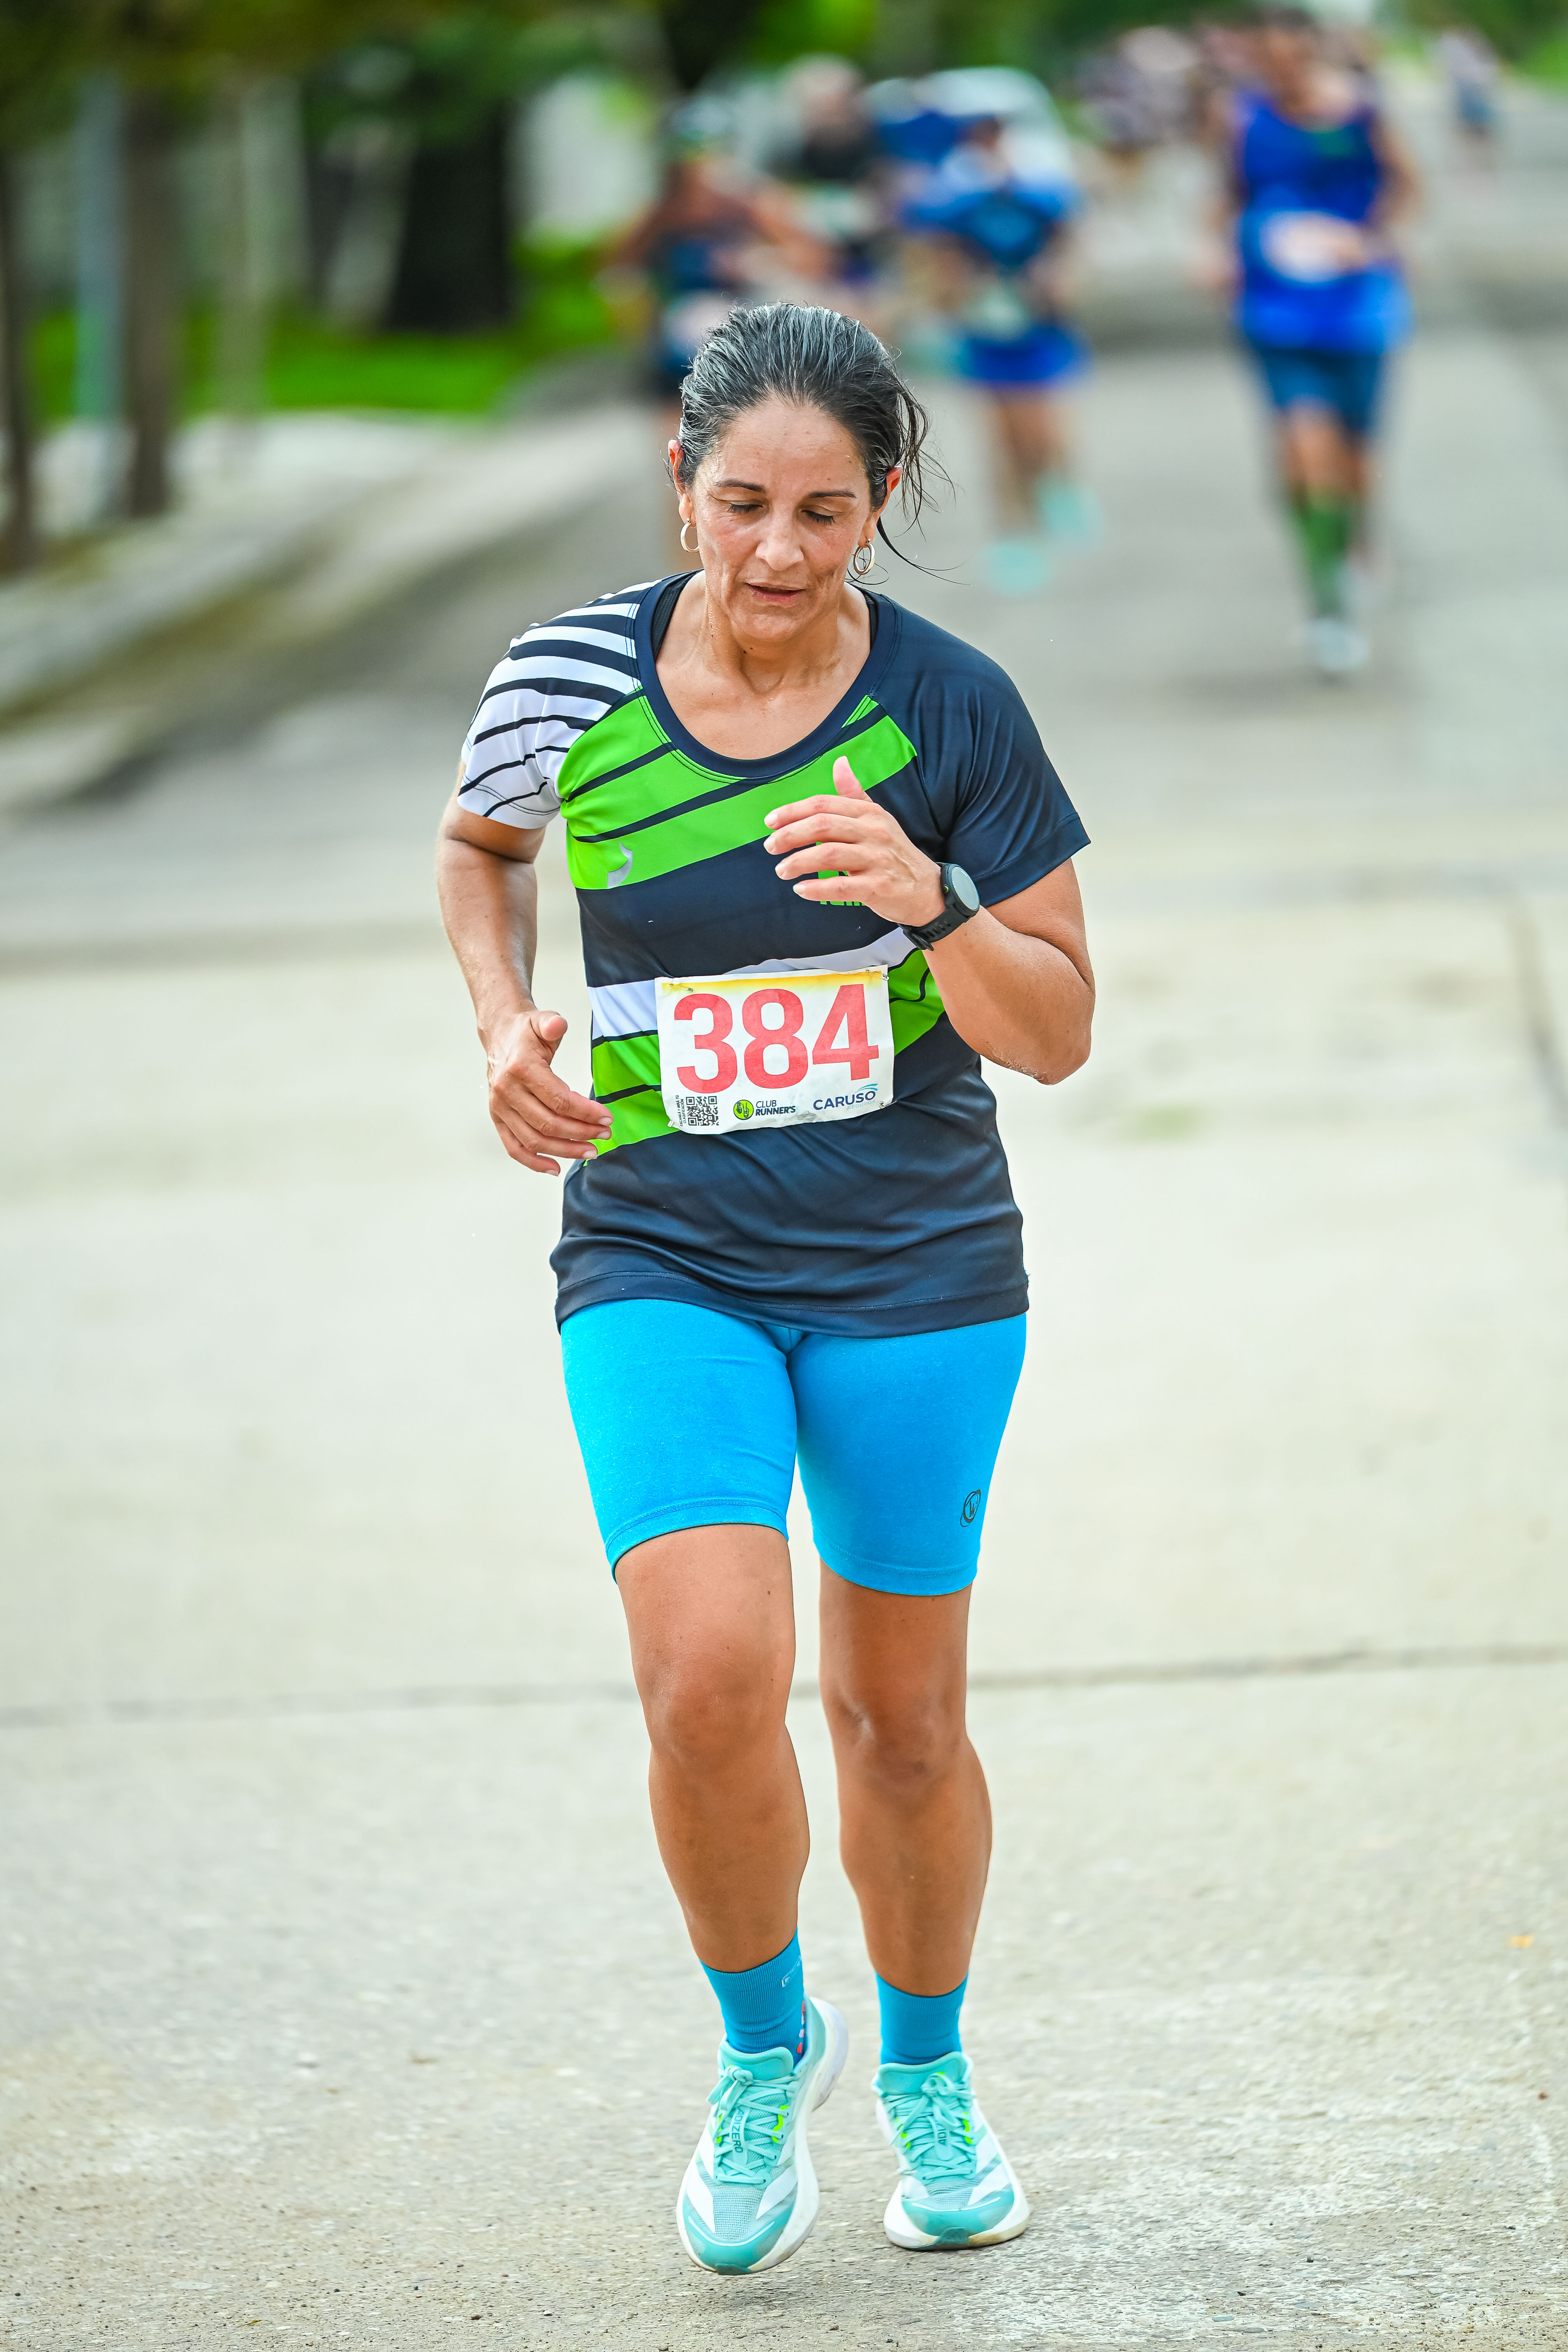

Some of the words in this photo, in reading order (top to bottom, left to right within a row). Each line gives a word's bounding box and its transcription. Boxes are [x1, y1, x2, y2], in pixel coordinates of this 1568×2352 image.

[674, 984, 879, 1094] 384
[756, 1100, 777, 1108] CLUB
[813, 1091, 876, 1110] CARUSO
[847, 1100, 875, 1110] SEGUROS
[755, 1106, 796, 1116] RUNNER'S
[732, 2108, 744, 2153] ADIZERO
